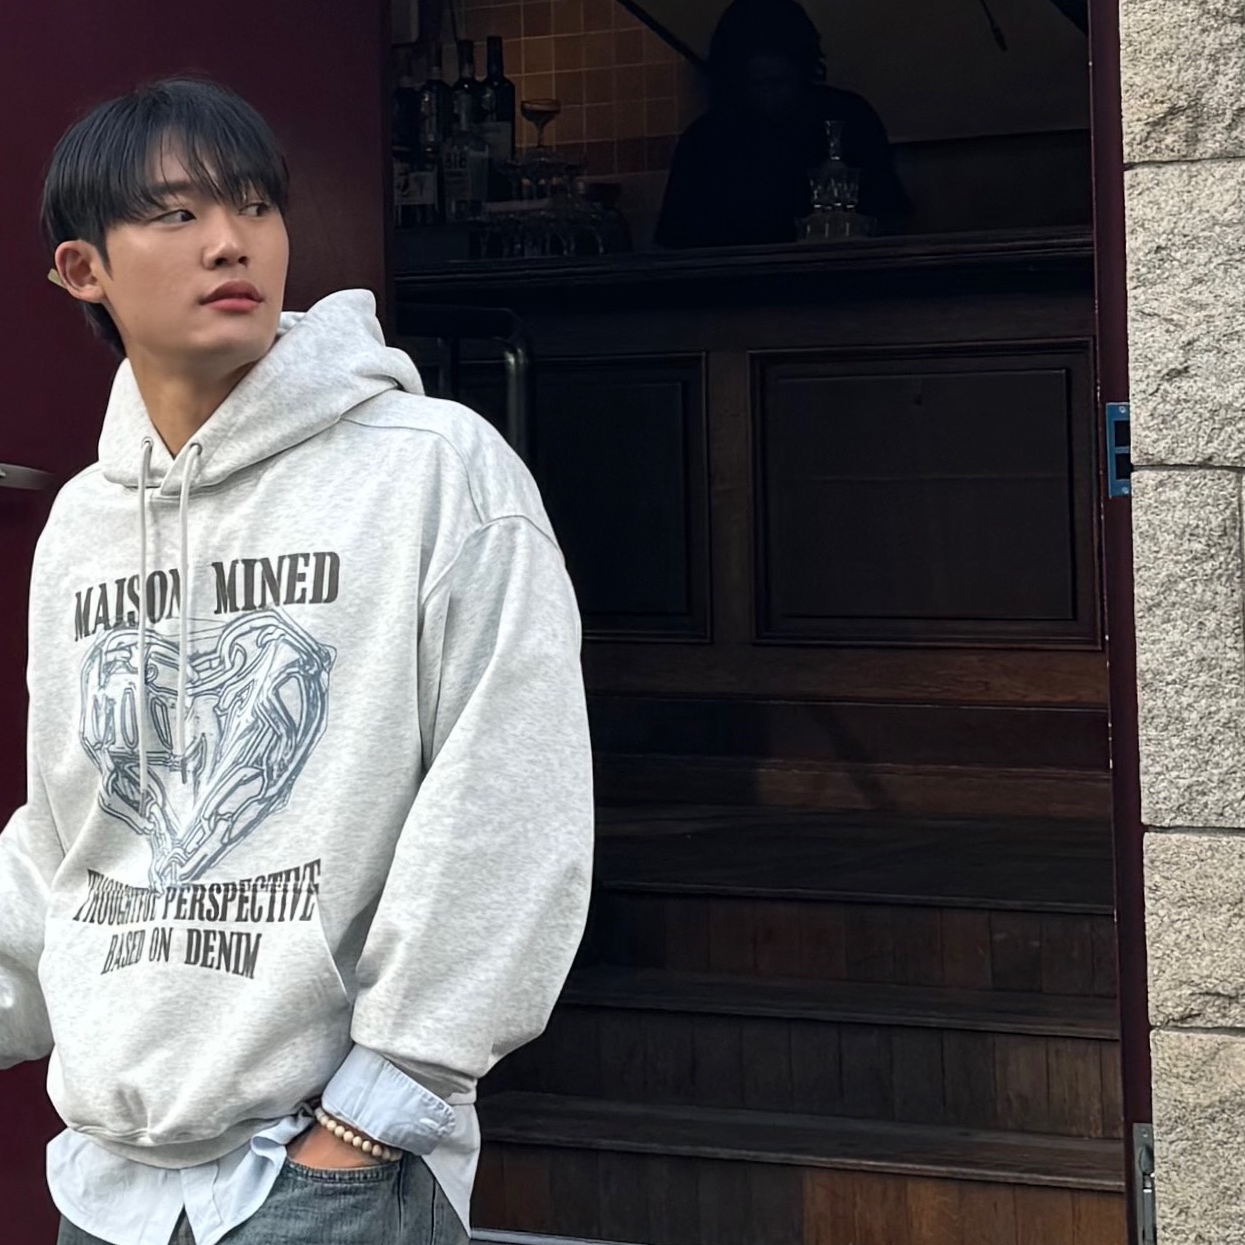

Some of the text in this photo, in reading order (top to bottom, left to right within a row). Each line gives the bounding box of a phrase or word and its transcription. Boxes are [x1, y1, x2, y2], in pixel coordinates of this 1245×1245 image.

[74, 551, 341, 642] MAISON MINED
[162, 858, 322, 923] PERSPECTIVE
[101, 926, 263, 979] BASED ON DENIM
